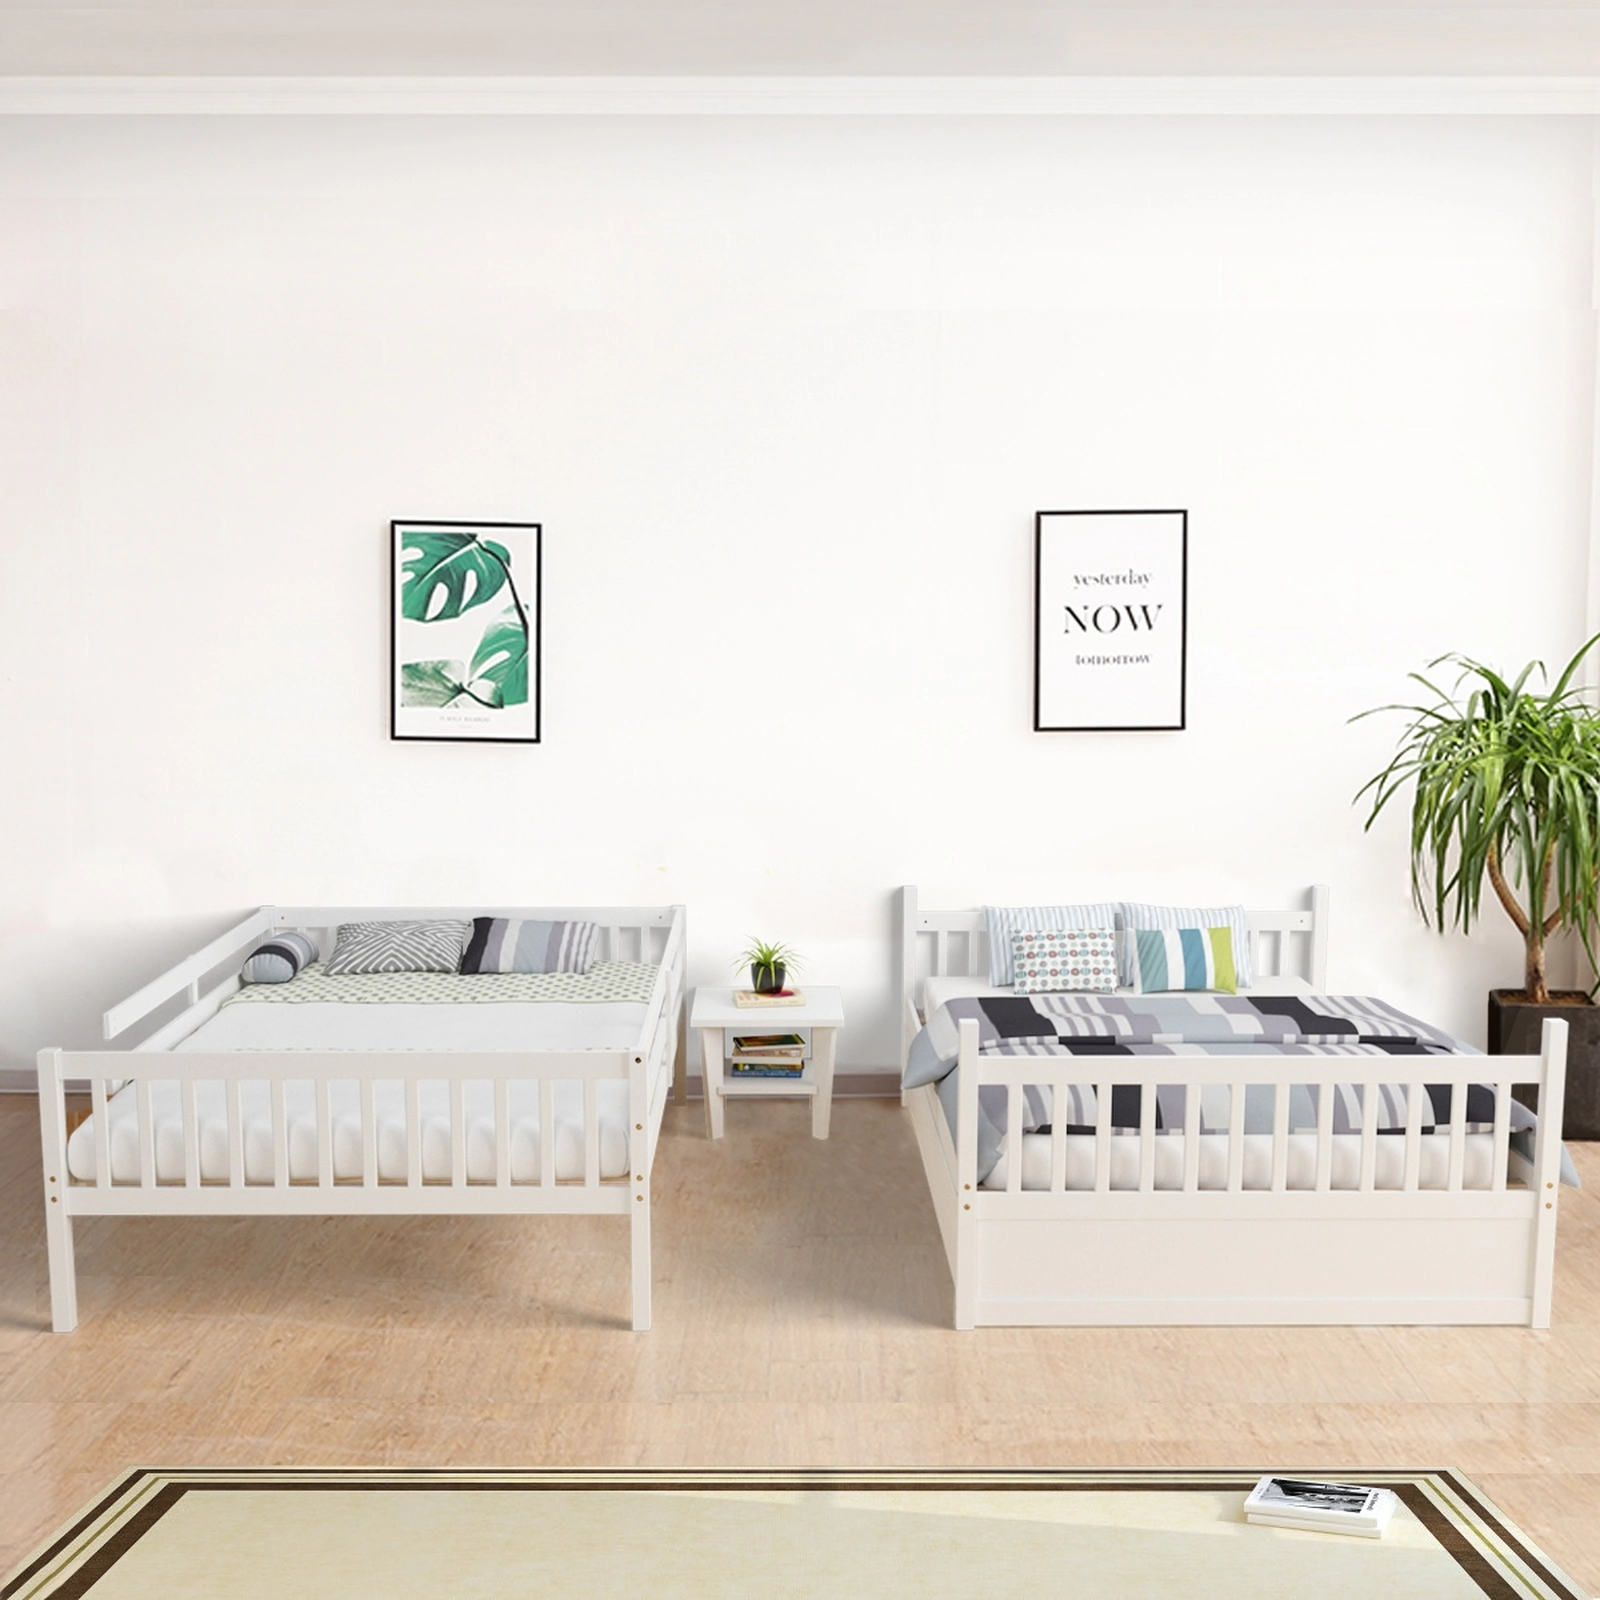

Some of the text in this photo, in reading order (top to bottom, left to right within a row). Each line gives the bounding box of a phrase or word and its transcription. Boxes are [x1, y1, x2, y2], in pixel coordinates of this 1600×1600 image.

[1073, 568, 1150, 589] yesterday
[1064, 604, 1162, 634] NOW
[1075, 653, 1151, 665] tomorrow
